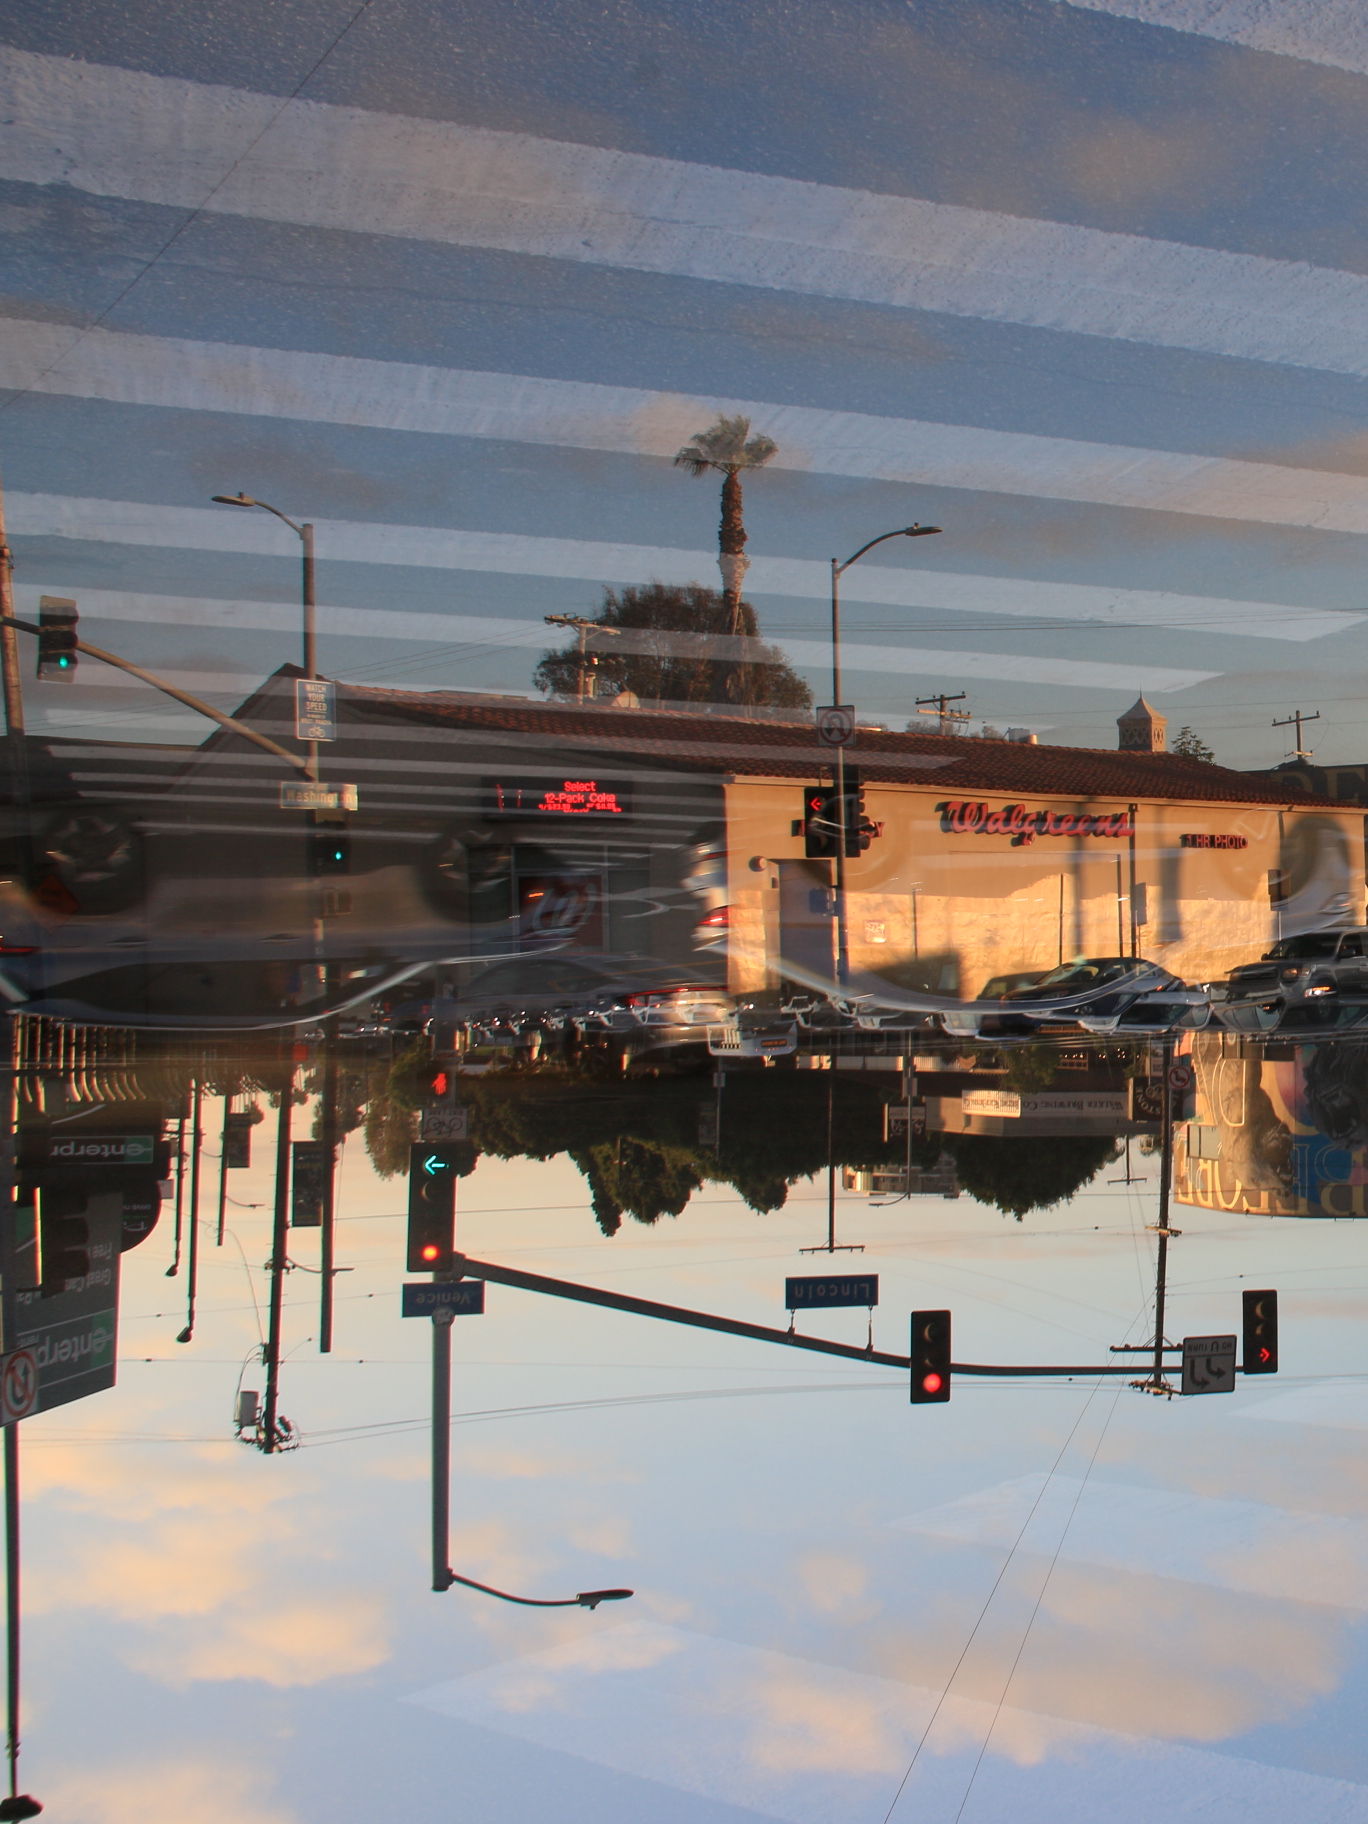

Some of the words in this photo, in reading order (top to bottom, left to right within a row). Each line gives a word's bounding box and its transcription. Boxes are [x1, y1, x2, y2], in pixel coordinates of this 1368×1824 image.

[304, 683, 327, 693] WATCH
[306, 692, 326, 702] YOUR
[305, 701, 328, 712] SPEED
[564, 781, 597, 792] Select
[544, 792, 585, 804] 12-Pack
[589, 792, 616, 803] Coke
[942, 800, 1136, 846] Walgreens
[1196, 834, 1211, 849] HR
[1214, 834, 1249, 849] PHOTO
[50, 1141, 144, 1160] enterpr
[794, 1283, 870, 1300] Lincoln
[415, 1291, 470, 1306] Venice
[37, 1327, 106, 1369] enterp
[1187, 1342, 1208, 1352] TURN
